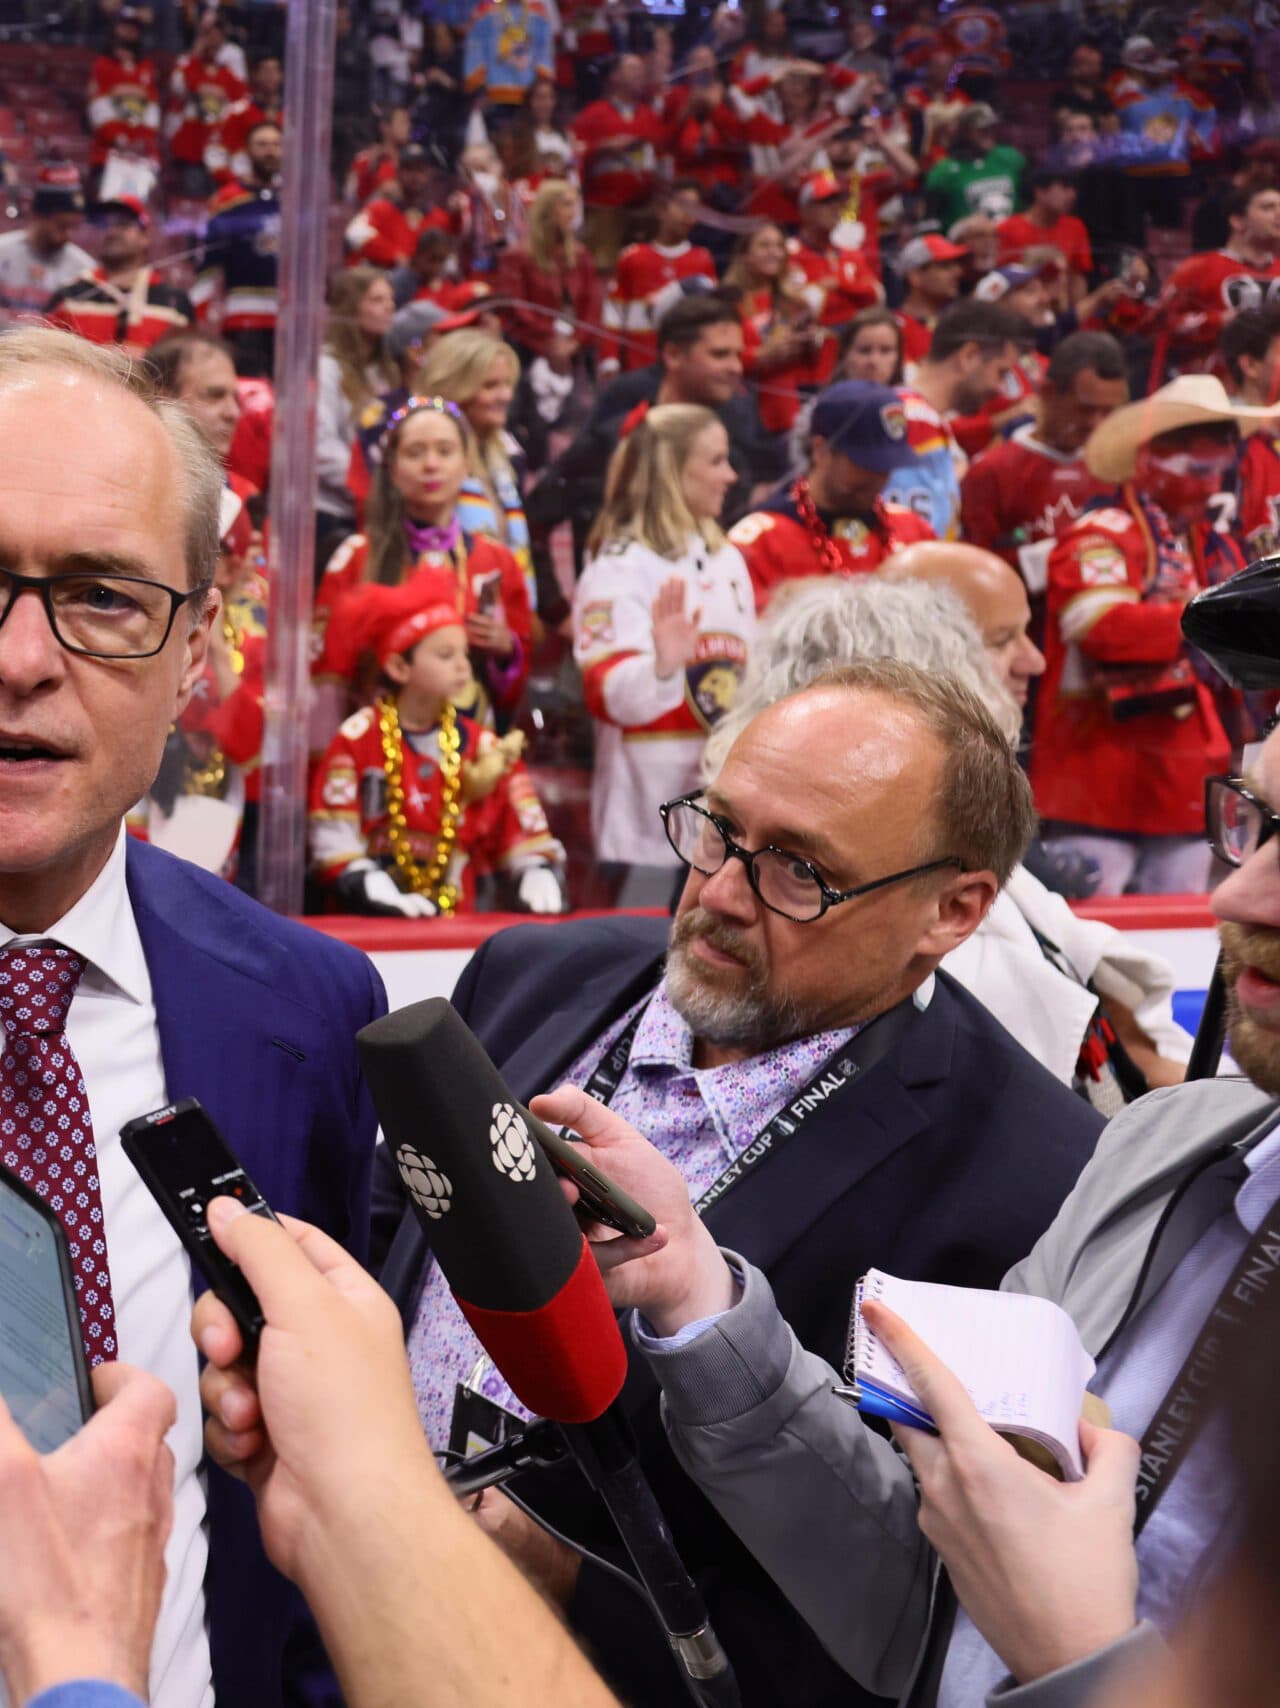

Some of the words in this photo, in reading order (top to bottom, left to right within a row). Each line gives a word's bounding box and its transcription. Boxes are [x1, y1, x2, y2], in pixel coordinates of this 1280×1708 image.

[146, 1105, 177, 1124] SONY
[694, 1163, 743, 1216] ANLEY
[742, 1132, 773, 1165] CUP
[790, 1072, 847, 1119] FINAL
[1135, 1386, 1196, 1501] STANLEY
